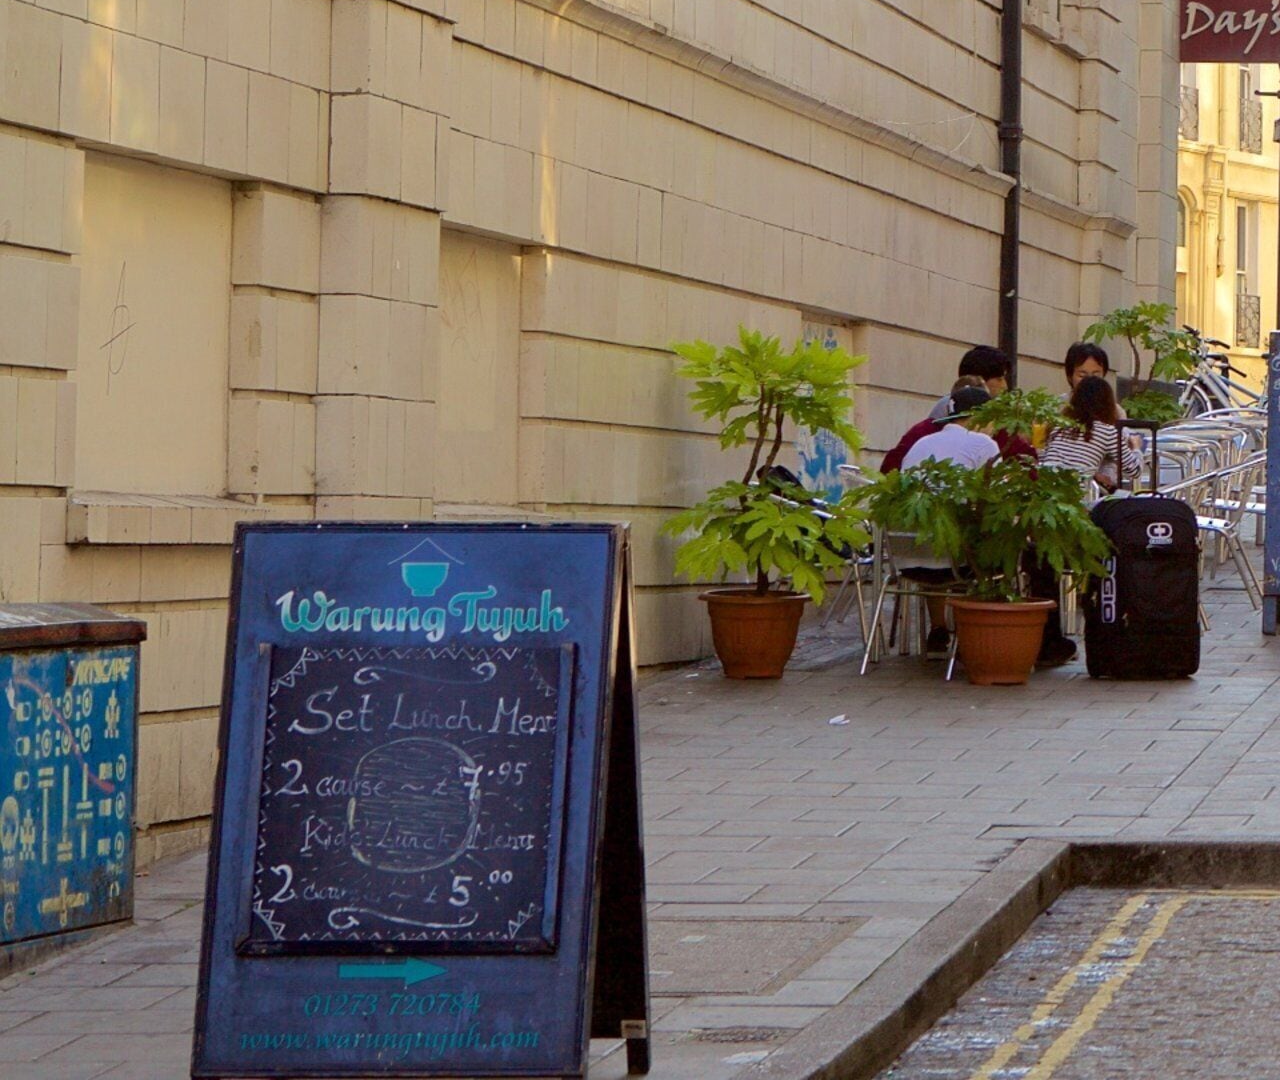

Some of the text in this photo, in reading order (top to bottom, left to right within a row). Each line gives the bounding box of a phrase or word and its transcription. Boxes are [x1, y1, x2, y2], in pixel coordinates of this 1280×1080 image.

[275, 584, 569, 642] Warung Tujuh
[287, 686, 375, 735] Set
[388, 693, 476, 731] Lunch
[274, 759, 308, 797] 2
[270, 864, 296, 903] 2
[304, 992, 481, 1017] 01273 720784
[240, 1022, 540, 1058] www.warungtujuh.com
